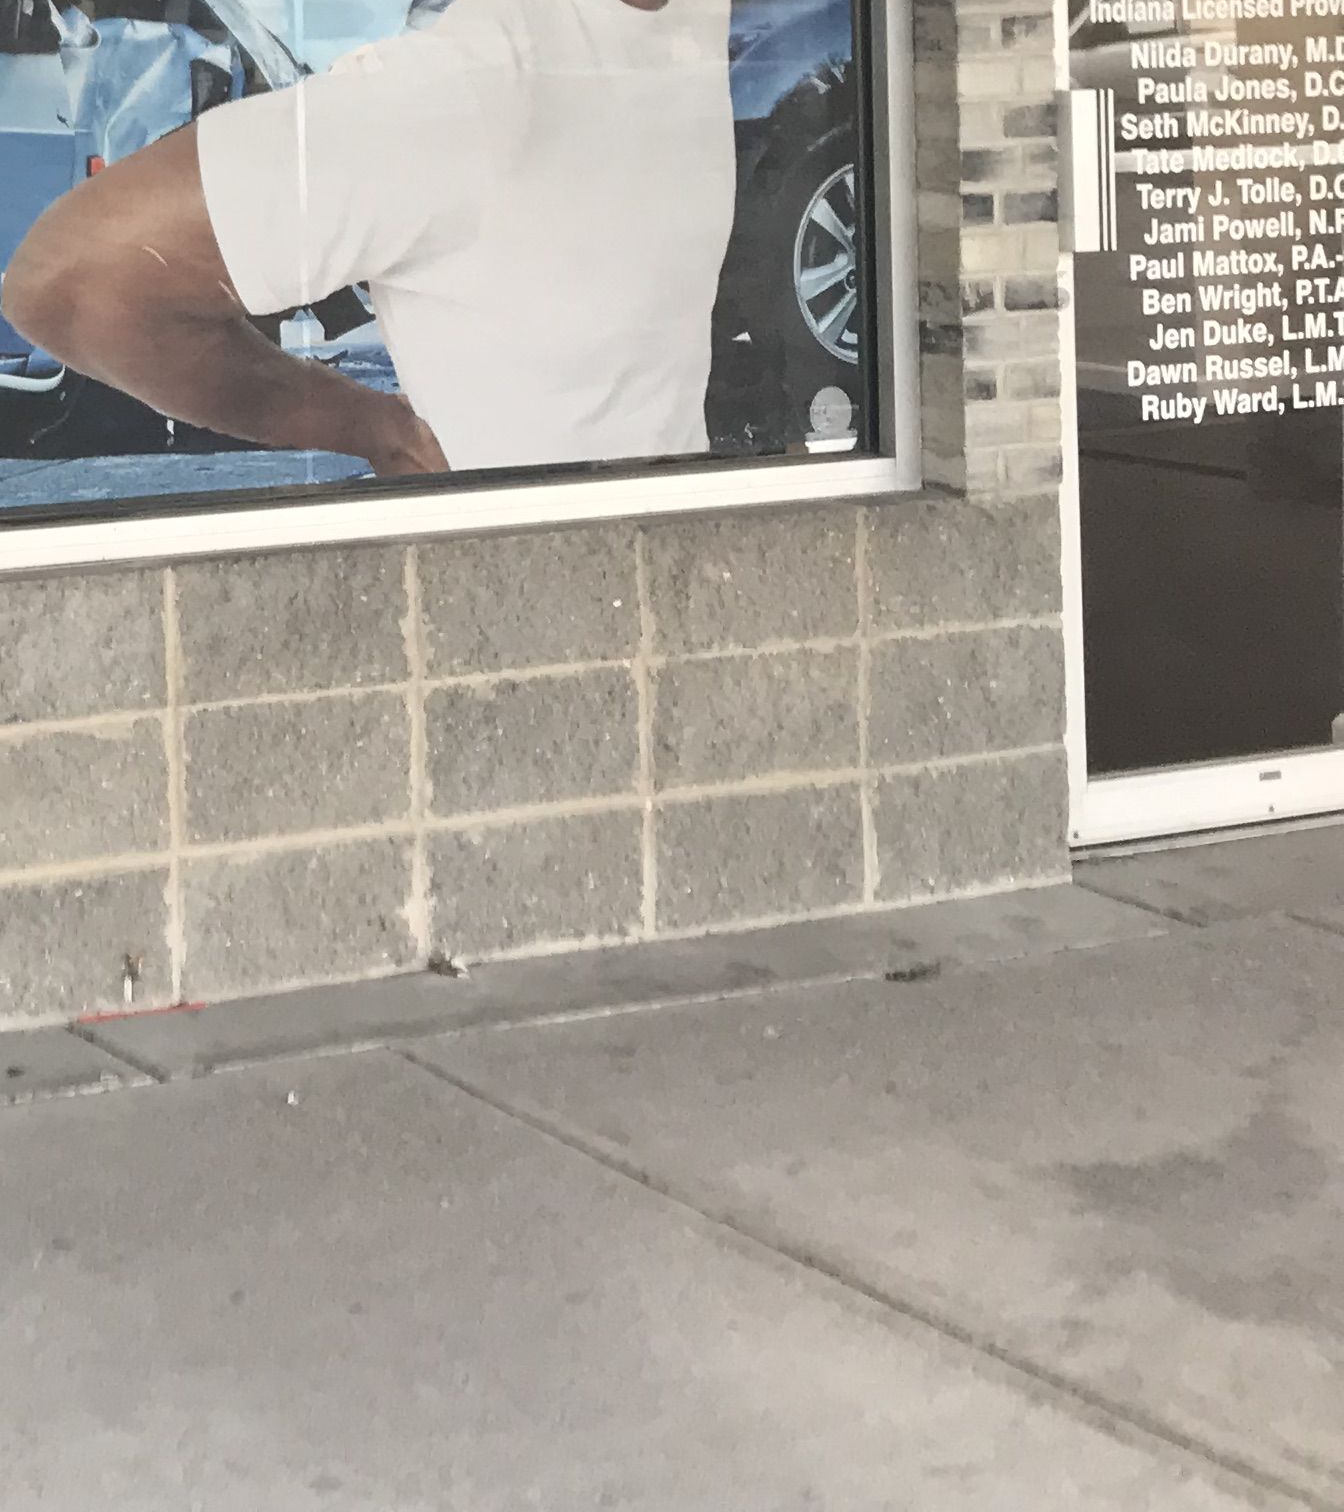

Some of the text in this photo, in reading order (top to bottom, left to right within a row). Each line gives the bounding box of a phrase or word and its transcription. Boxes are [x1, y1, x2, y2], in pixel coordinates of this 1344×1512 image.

[1131, 41, 1196, 69] Nilda
[1204, 40, 1298, 71] Durany,
[1138, 76, 1207, 104] Paula
[1214, 76, 1297, 103] Jones,
[1121, 112, 1179, 140] Seth
[1186, 108, 1315, 139] McKinney,
[1131, 147, 1184, 175] Tate
[1192, 142, 1305, 172] Medlock,
[1136, 183, 1201, 214] Terry
[1208, 180, 1230, 207] J.
[1236, 177, 1302, 207] Tolle,
[1144, 216, 1205, 245] Jami
[1212, 211, 1302, 241] Powell,
[1129, 252, 1185, 281] Paul
[1192, 250, 1284, 277] Mattox,
[1142, 289, 1192, 316] Ben
[1198, 282, 1288, 315] Wright,
[1149, 323, 1195, 351] Jen
[1203, 318, 1275, 347] Duke,
[1127, 360, 1197, 387] Dawn
[1205, 349, 1298, 381] Russel,
[1141, 392, 1207, 424] Ruby
[1212, 385, 1285, 416] Ward,
